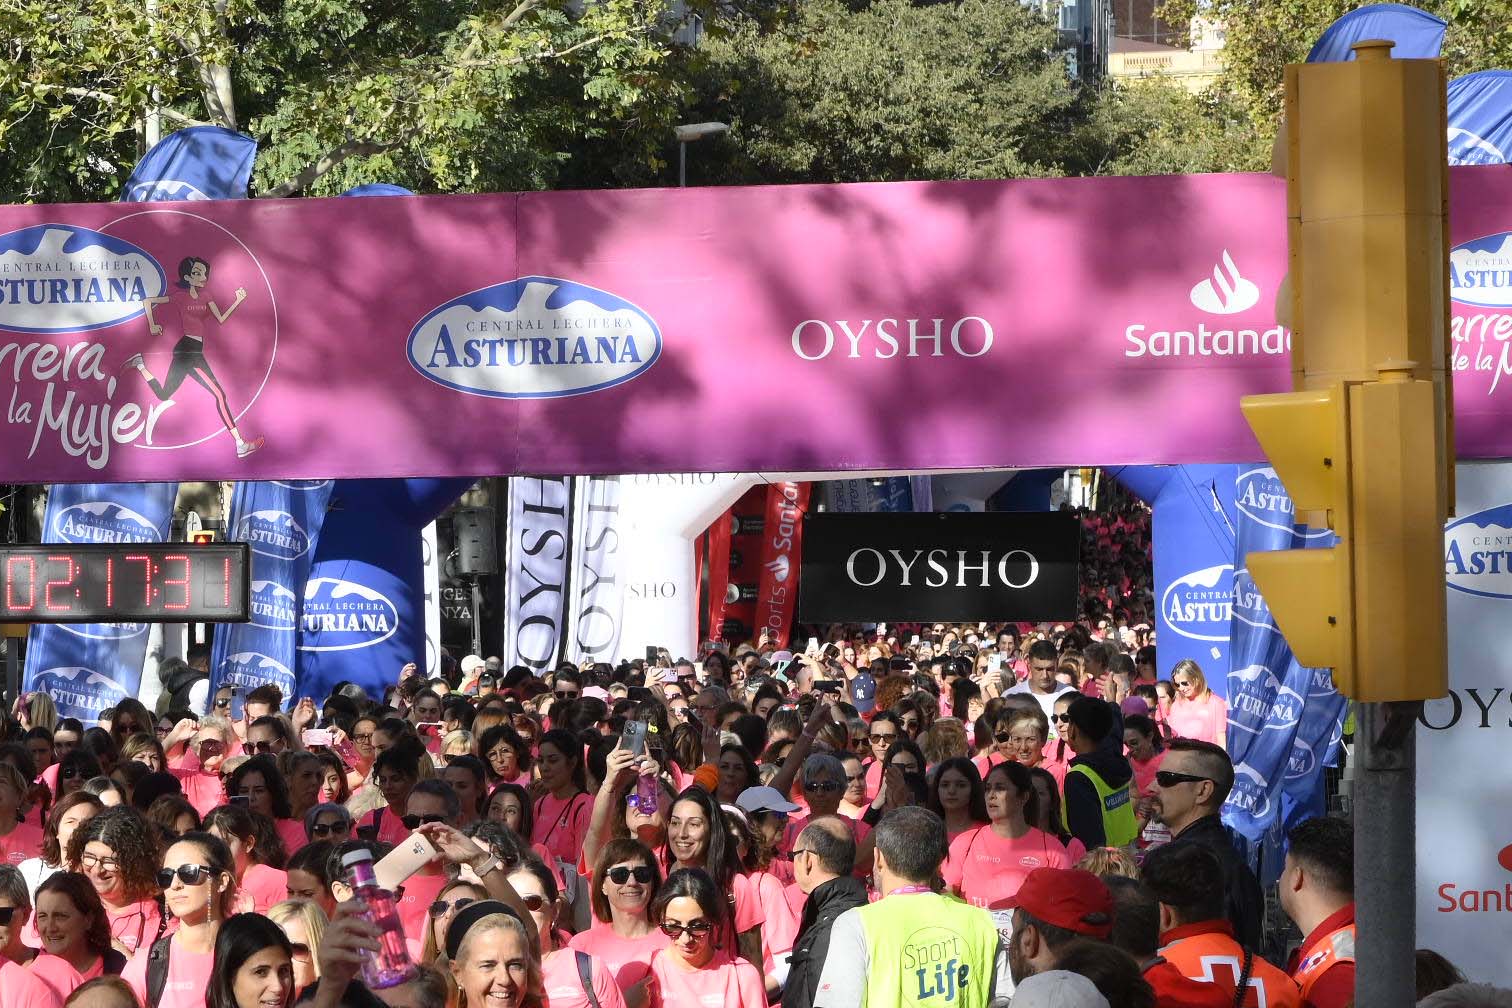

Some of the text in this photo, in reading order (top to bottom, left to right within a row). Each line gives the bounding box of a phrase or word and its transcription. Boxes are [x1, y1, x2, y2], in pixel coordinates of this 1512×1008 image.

[69, 261, 141, 273] LECHERA
[465, 317, 633, 332] CENTRAL LECHERA
[791, 316, 994, 360] OYSHO
[1125, 323, 1291, 358] Santan
[1451, 313, 1512, 343] arre
[426, 324, 642, 368] ASTURIANA
[1475, 344, 1492, 371] la
[7, 382, 32, 424] la
[28, 377, 176, 470] Mujer
[7, 555, 231, 611] 02:17:31
[846, 547, 1039, 589] OYSHO
[335, 602, 385, 611] LECHERA
[1186, 591, 1232, 600] CENTRA
[299, 613, 389, 633] TURIANA
[905, 938, 960, 970] Sport
[916, 958, 969, 1002] Life
